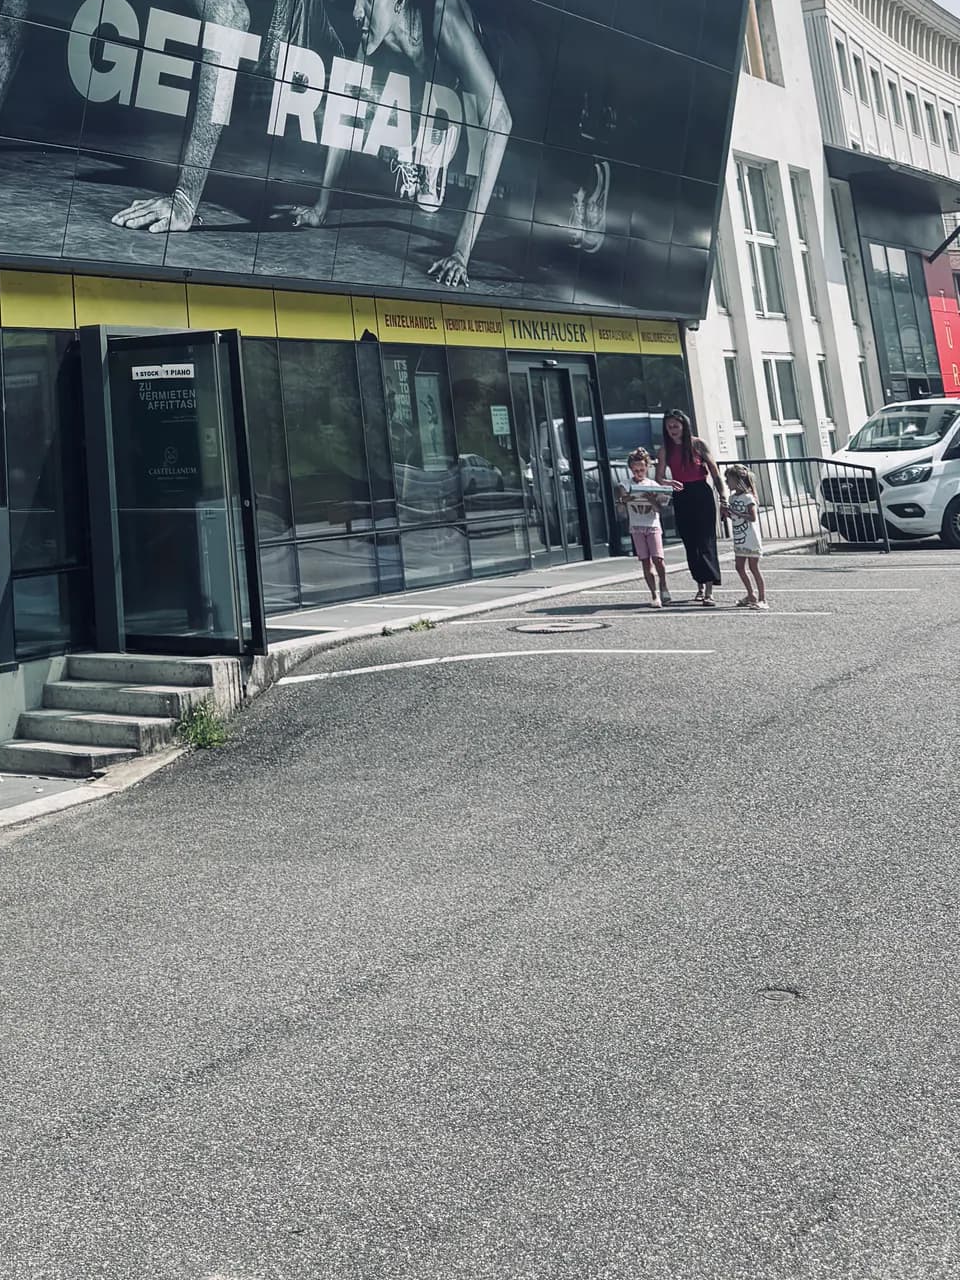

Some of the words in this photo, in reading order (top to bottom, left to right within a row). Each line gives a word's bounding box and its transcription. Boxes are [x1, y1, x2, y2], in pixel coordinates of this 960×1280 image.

[267, 41, 498, 176] READY
[385, 314, 438, 330] EINZELHANDEL
[509, 319, 587, 343] TINKHAUSER
[139, 382, 152, 391] ZU
[139, 389, 196, 401] VERMIETEN
[147, 400, 197, 410] AFFITTASI
